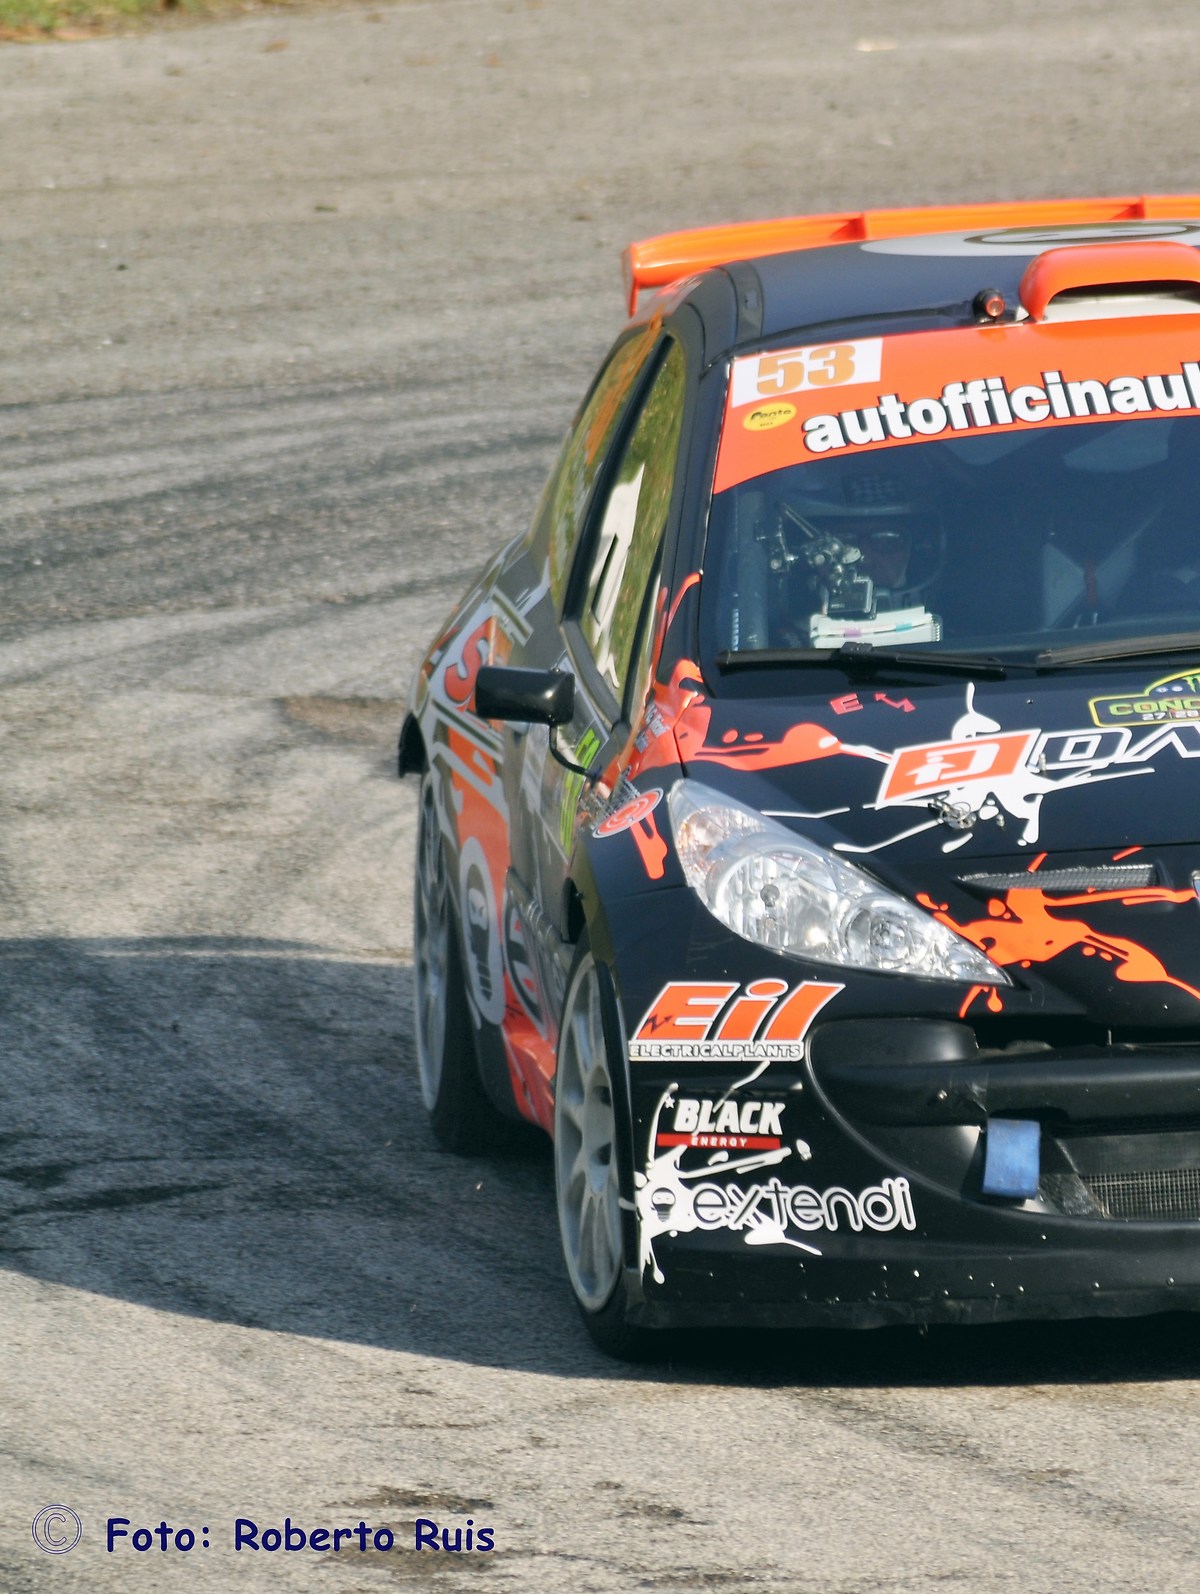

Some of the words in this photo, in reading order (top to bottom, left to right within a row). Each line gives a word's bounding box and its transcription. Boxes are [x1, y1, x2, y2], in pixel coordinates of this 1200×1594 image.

[757, 345, 857, 396] 53
[629, 977, 847, 1042] Eil
[673, 1099, 786, 1135] BLACK
[690, 1136, 749, 1148] ENERGY
[692, 1176, 918, 1233] extendi
